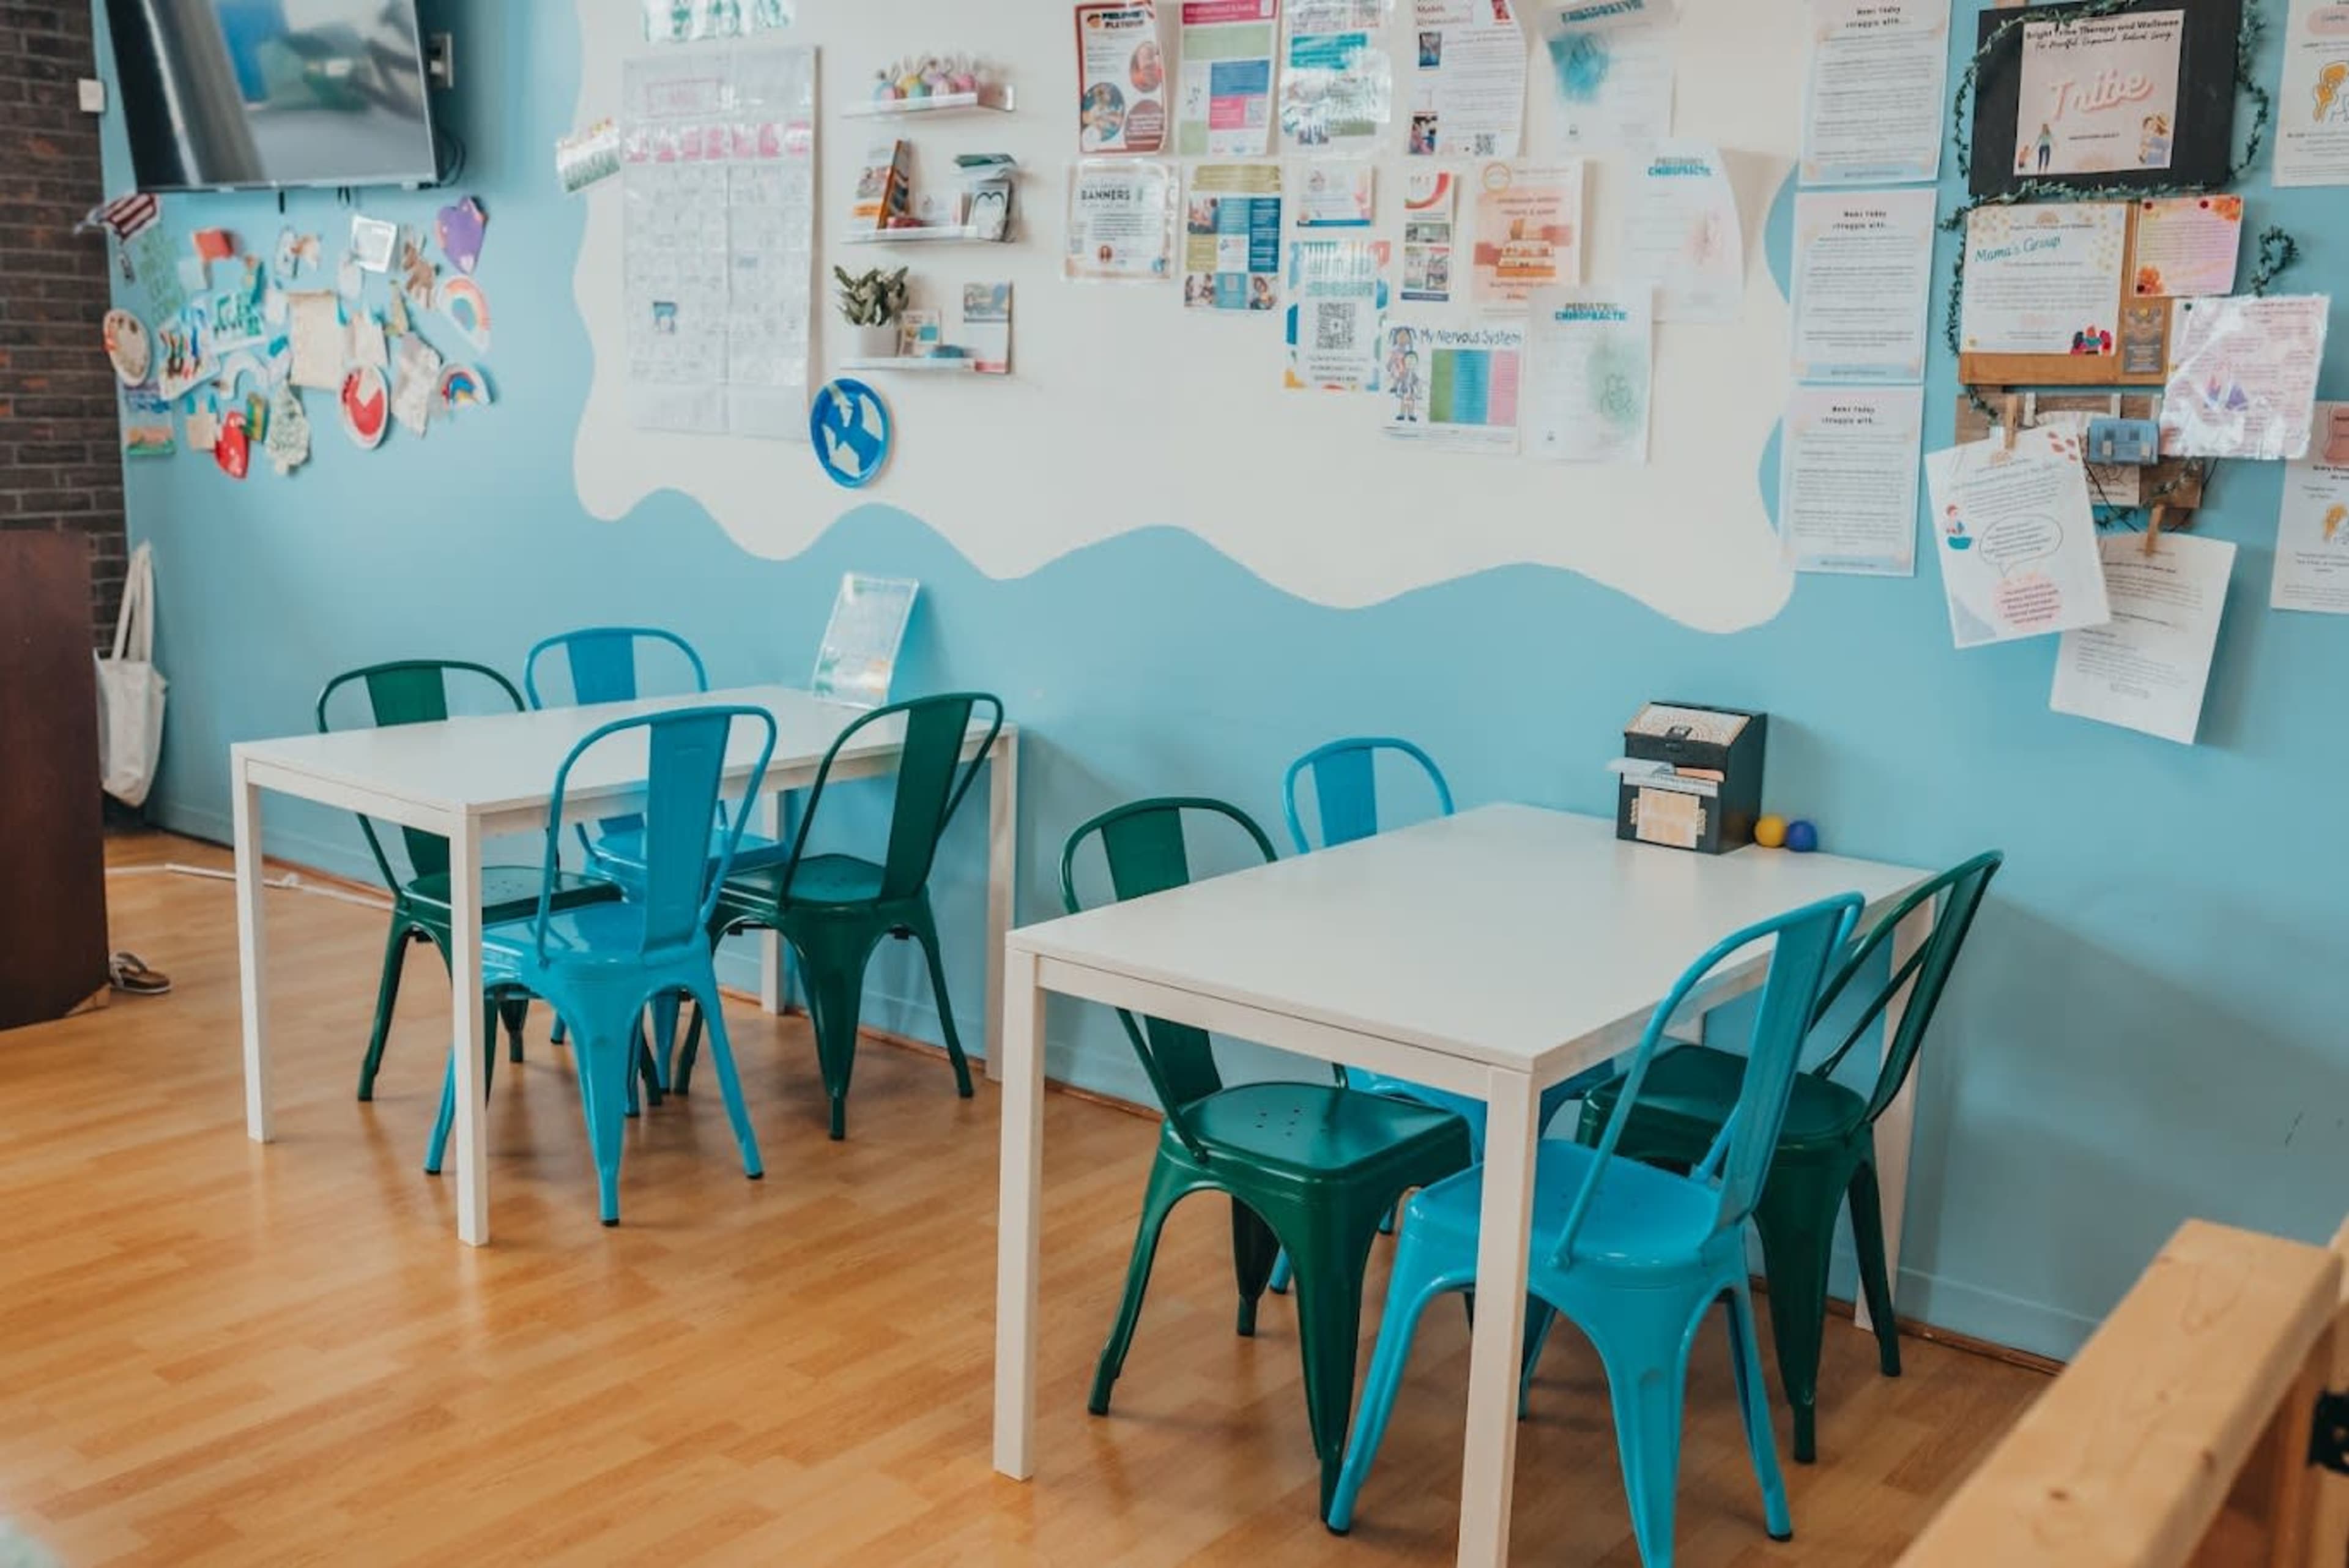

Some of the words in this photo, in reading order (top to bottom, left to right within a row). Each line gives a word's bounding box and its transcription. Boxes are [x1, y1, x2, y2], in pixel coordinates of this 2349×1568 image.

[2117, 22, 2135, 31] and
[2137, 18, 2180, 29] Wellness
[2049, 69, 2155, 122] Tribe
[1081, 190, 1130, 201] BANNERS
[2022, 236, 2061, 254] Group
[1554, 310, 1627, 321] CHIROPRACTIC
[1420, 328, 1433, 344] My
[1438, 329, 1480, 344] Nervous
[1483, 329, 1523, 345] System
